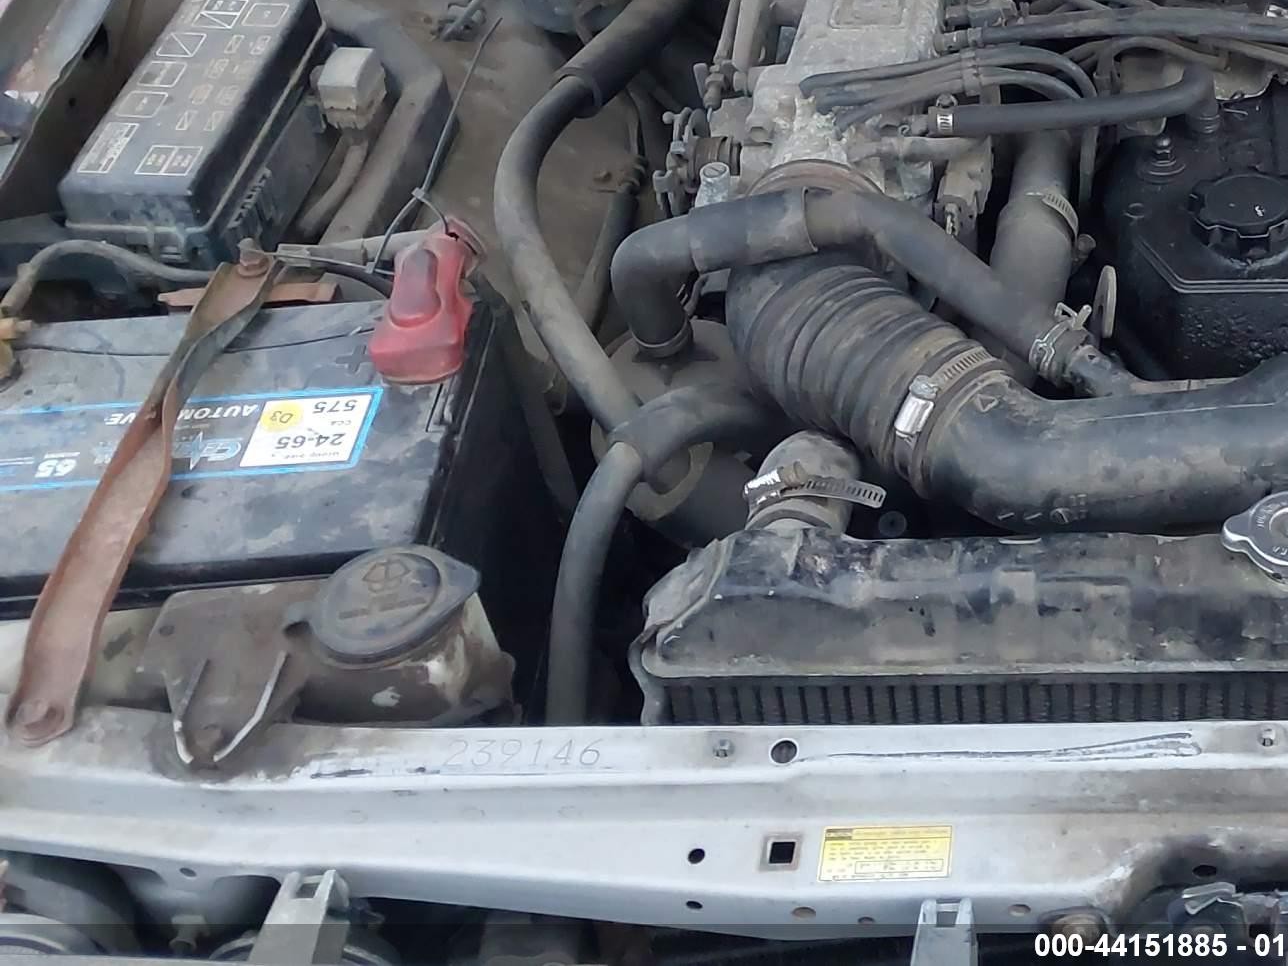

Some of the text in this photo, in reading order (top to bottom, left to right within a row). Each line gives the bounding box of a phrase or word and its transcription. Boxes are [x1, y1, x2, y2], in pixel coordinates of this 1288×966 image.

[312, 399, 358, 414] 575
[270, 410, 294, 424] D3
[275, 433, 346, 450] 24-65
[35, 459, 77, 478] 65
[442, 738, 604, 767] 239146
